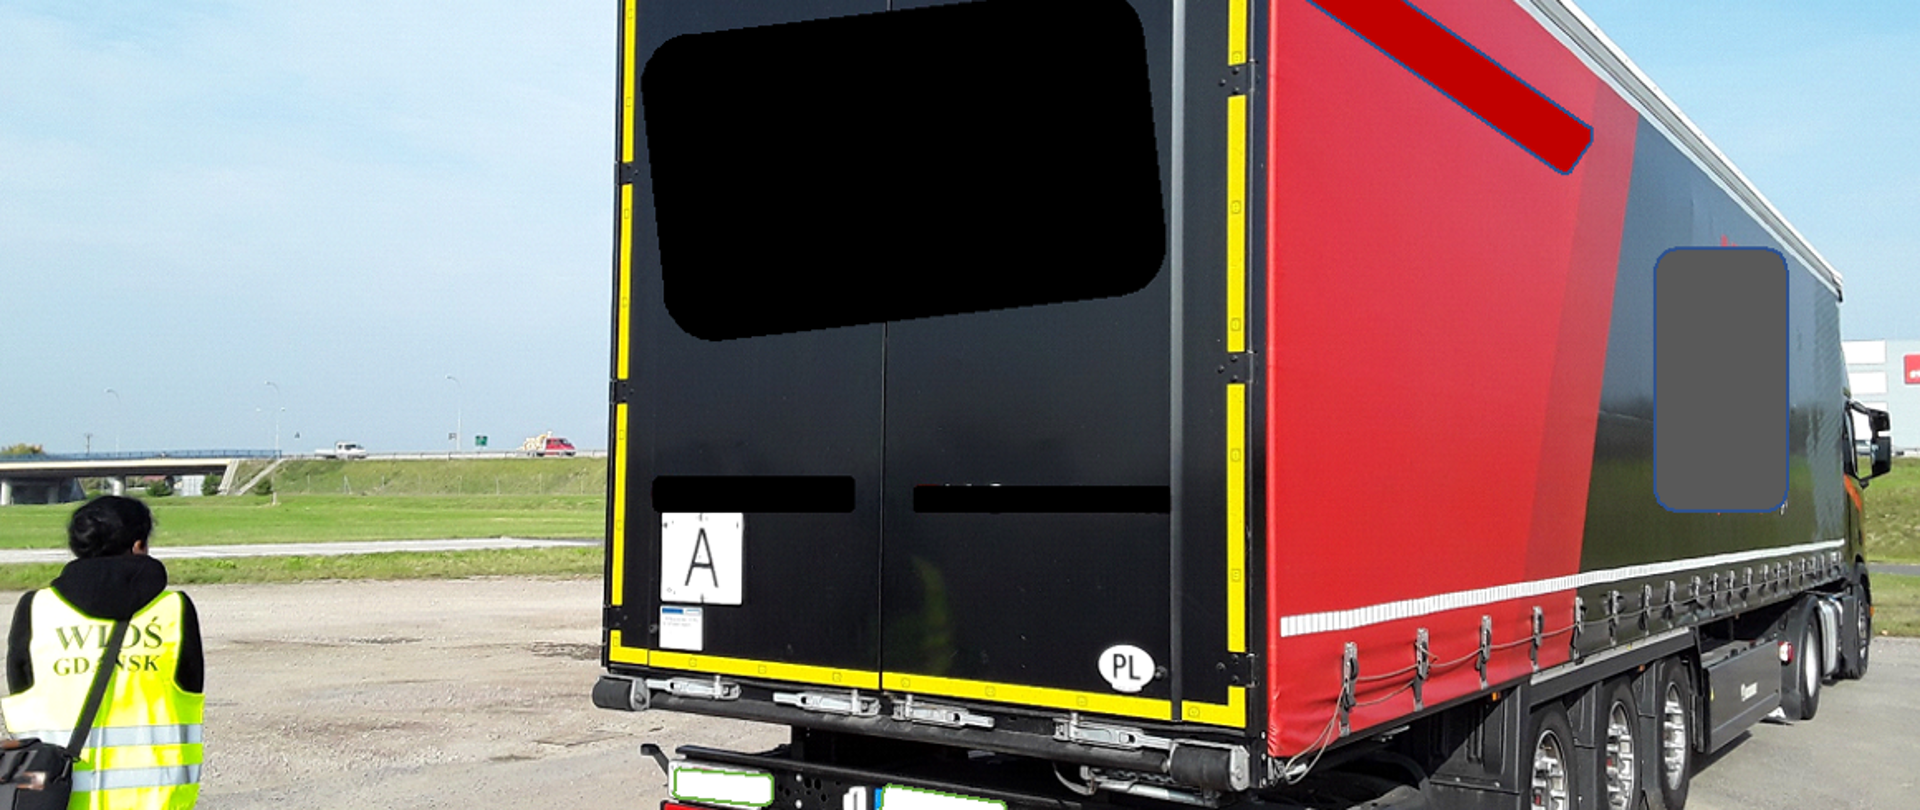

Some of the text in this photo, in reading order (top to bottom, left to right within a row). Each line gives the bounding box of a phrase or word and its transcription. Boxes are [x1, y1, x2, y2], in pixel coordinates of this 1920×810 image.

[684, 527, 719, 588] A
[53, 654, 160, 676] GDSK
[1113, 653, 1141, 680] PL
